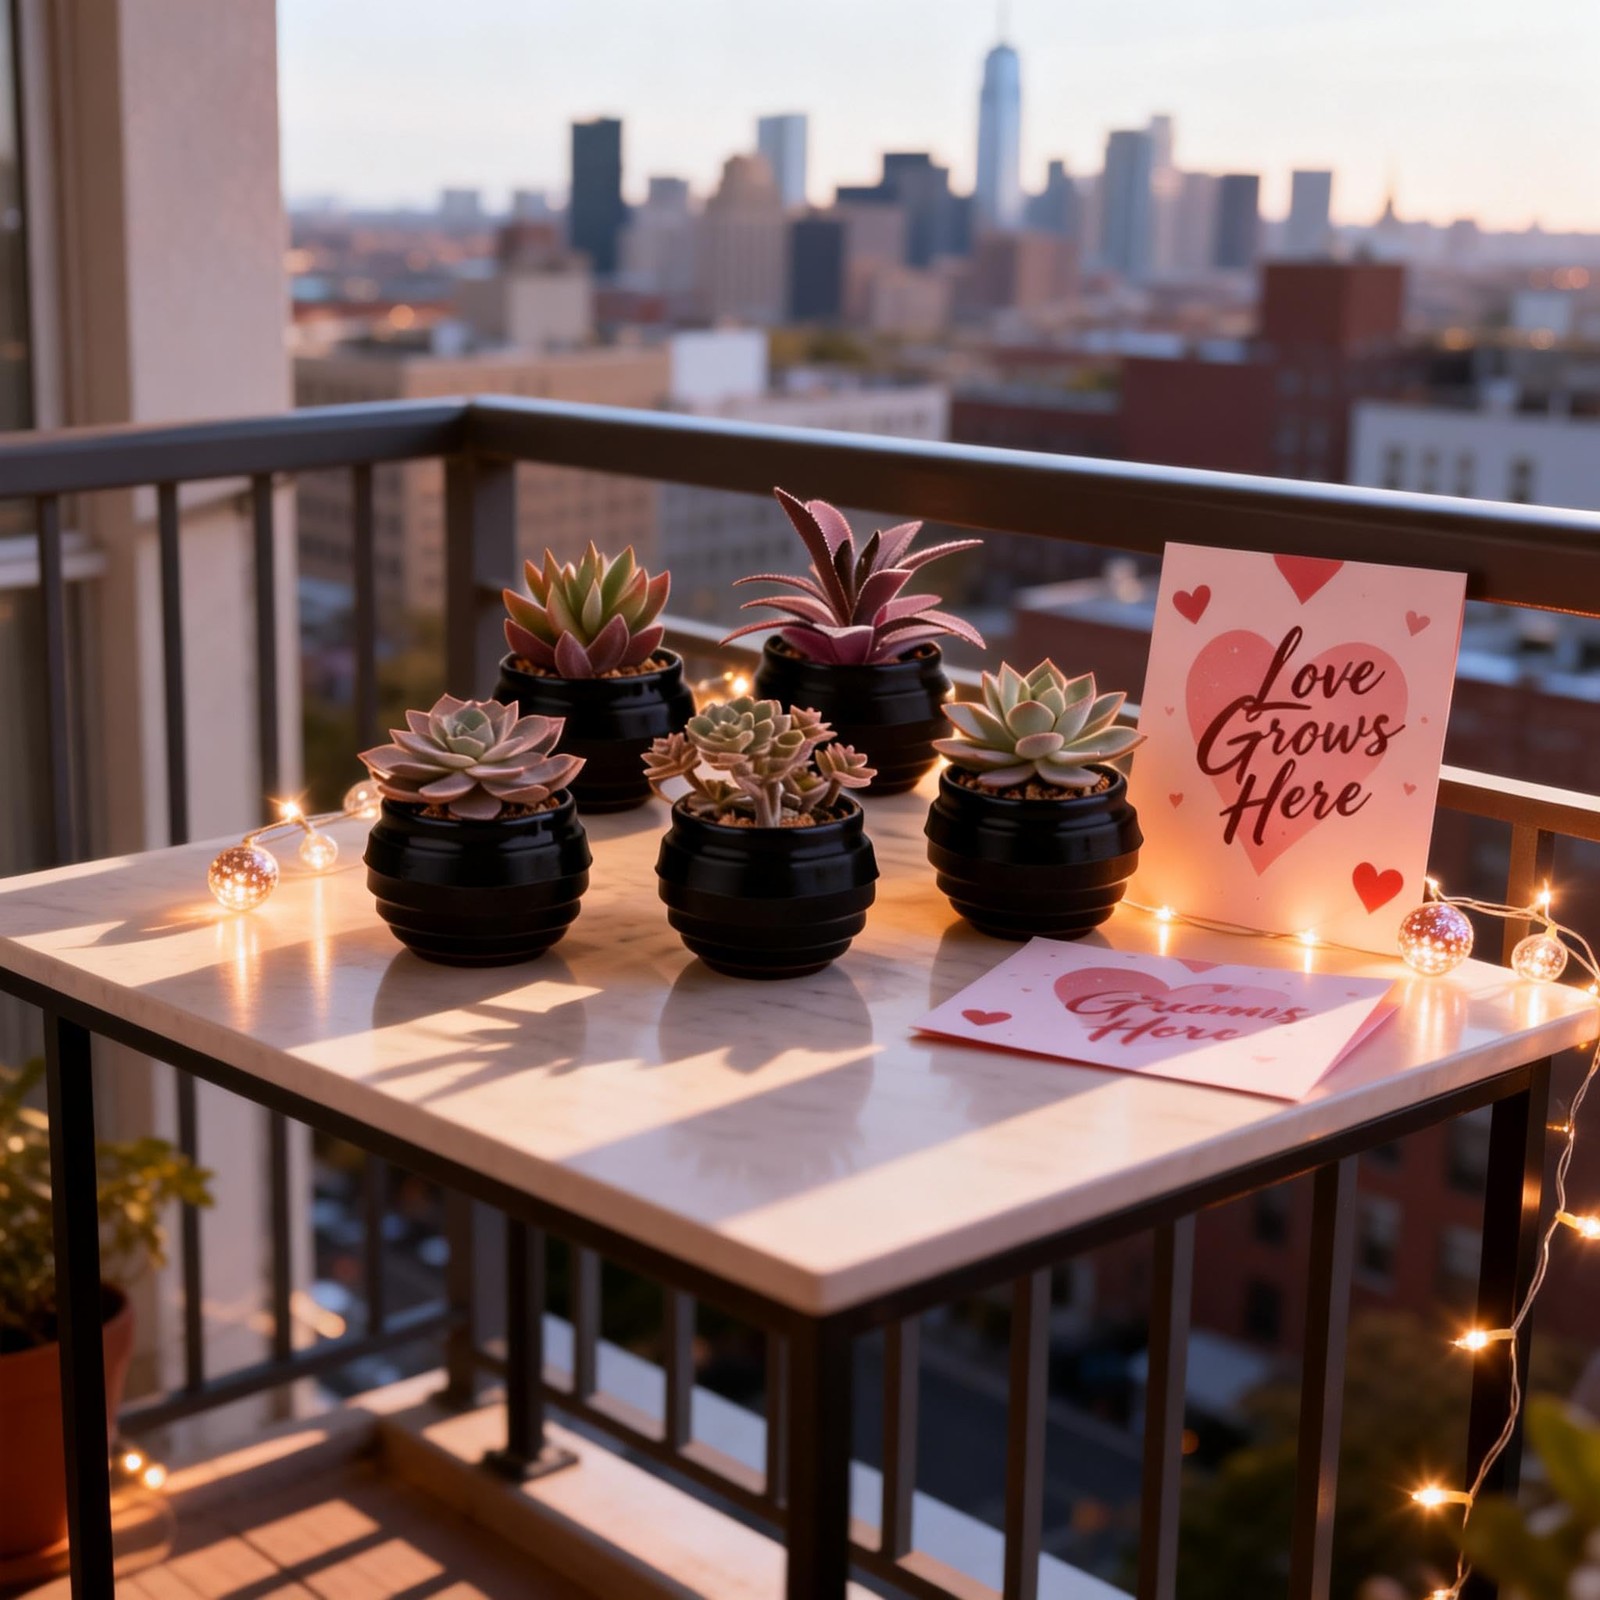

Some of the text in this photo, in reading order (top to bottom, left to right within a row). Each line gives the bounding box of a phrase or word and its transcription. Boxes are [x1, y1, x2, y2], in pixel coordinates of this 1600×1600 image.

[1246, 625, 1386, 722] Love
[1196, 694, 1406, 785] Grows
[1219, 758, 1373, 846] Here
